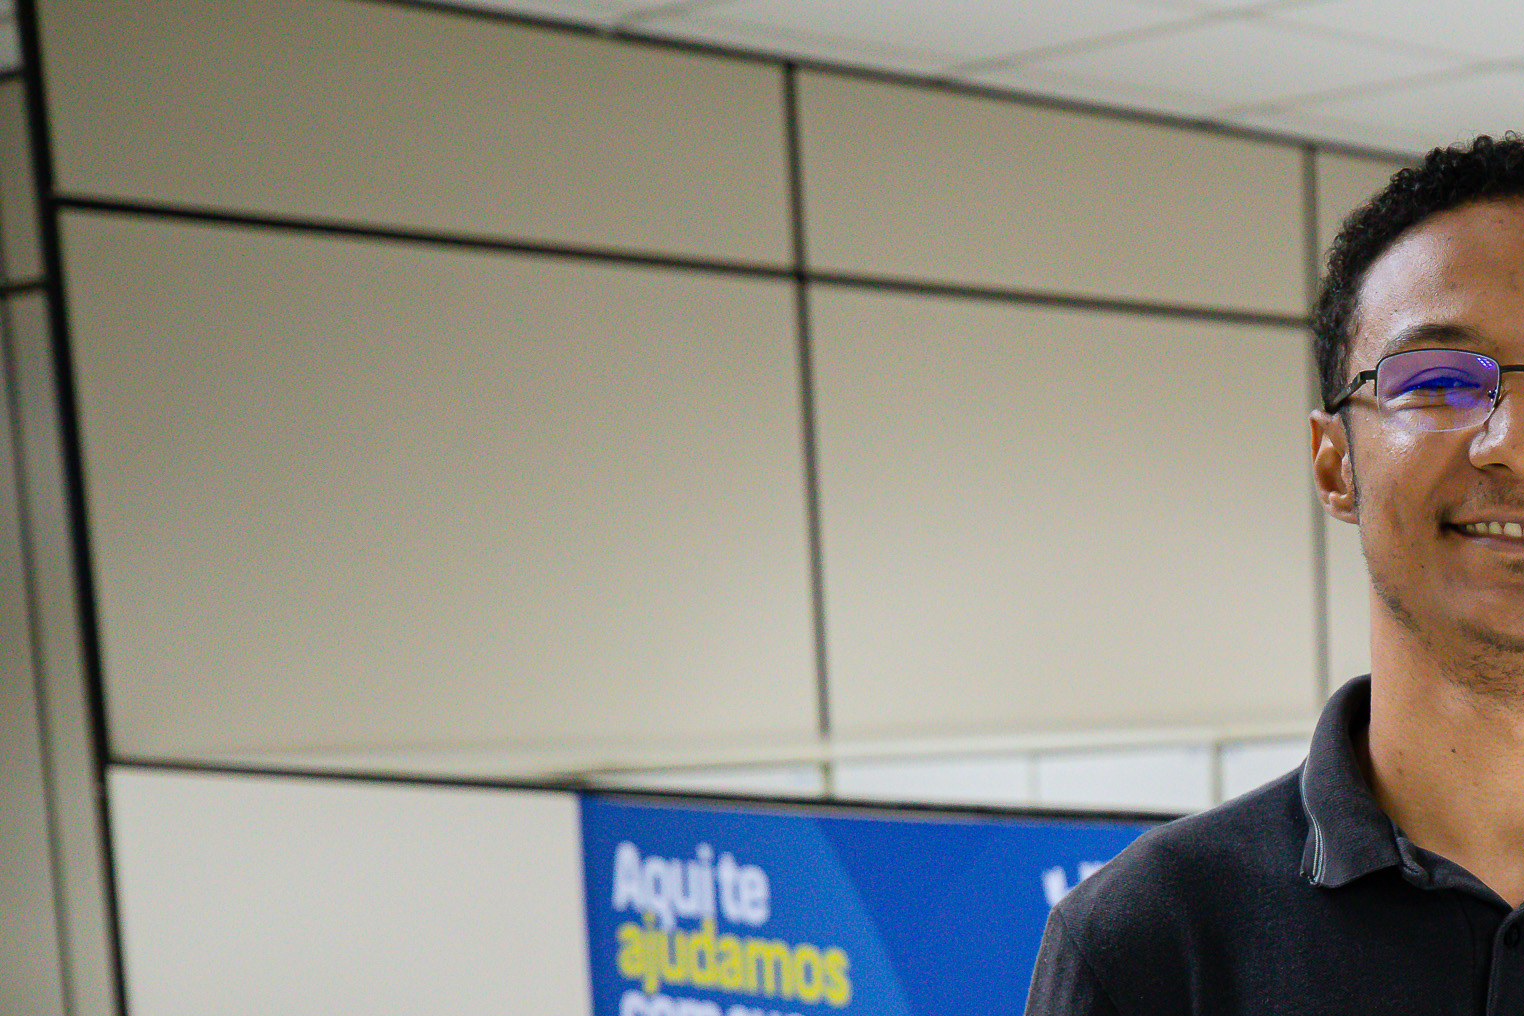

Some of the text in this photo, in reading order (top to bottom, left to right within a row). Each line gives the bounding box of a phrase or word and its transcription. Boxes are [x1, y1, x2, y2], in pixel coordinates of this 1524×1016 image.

[612, 841, 770, 929] Aqui te
[617, 911, 852, 1008] ajudamos
